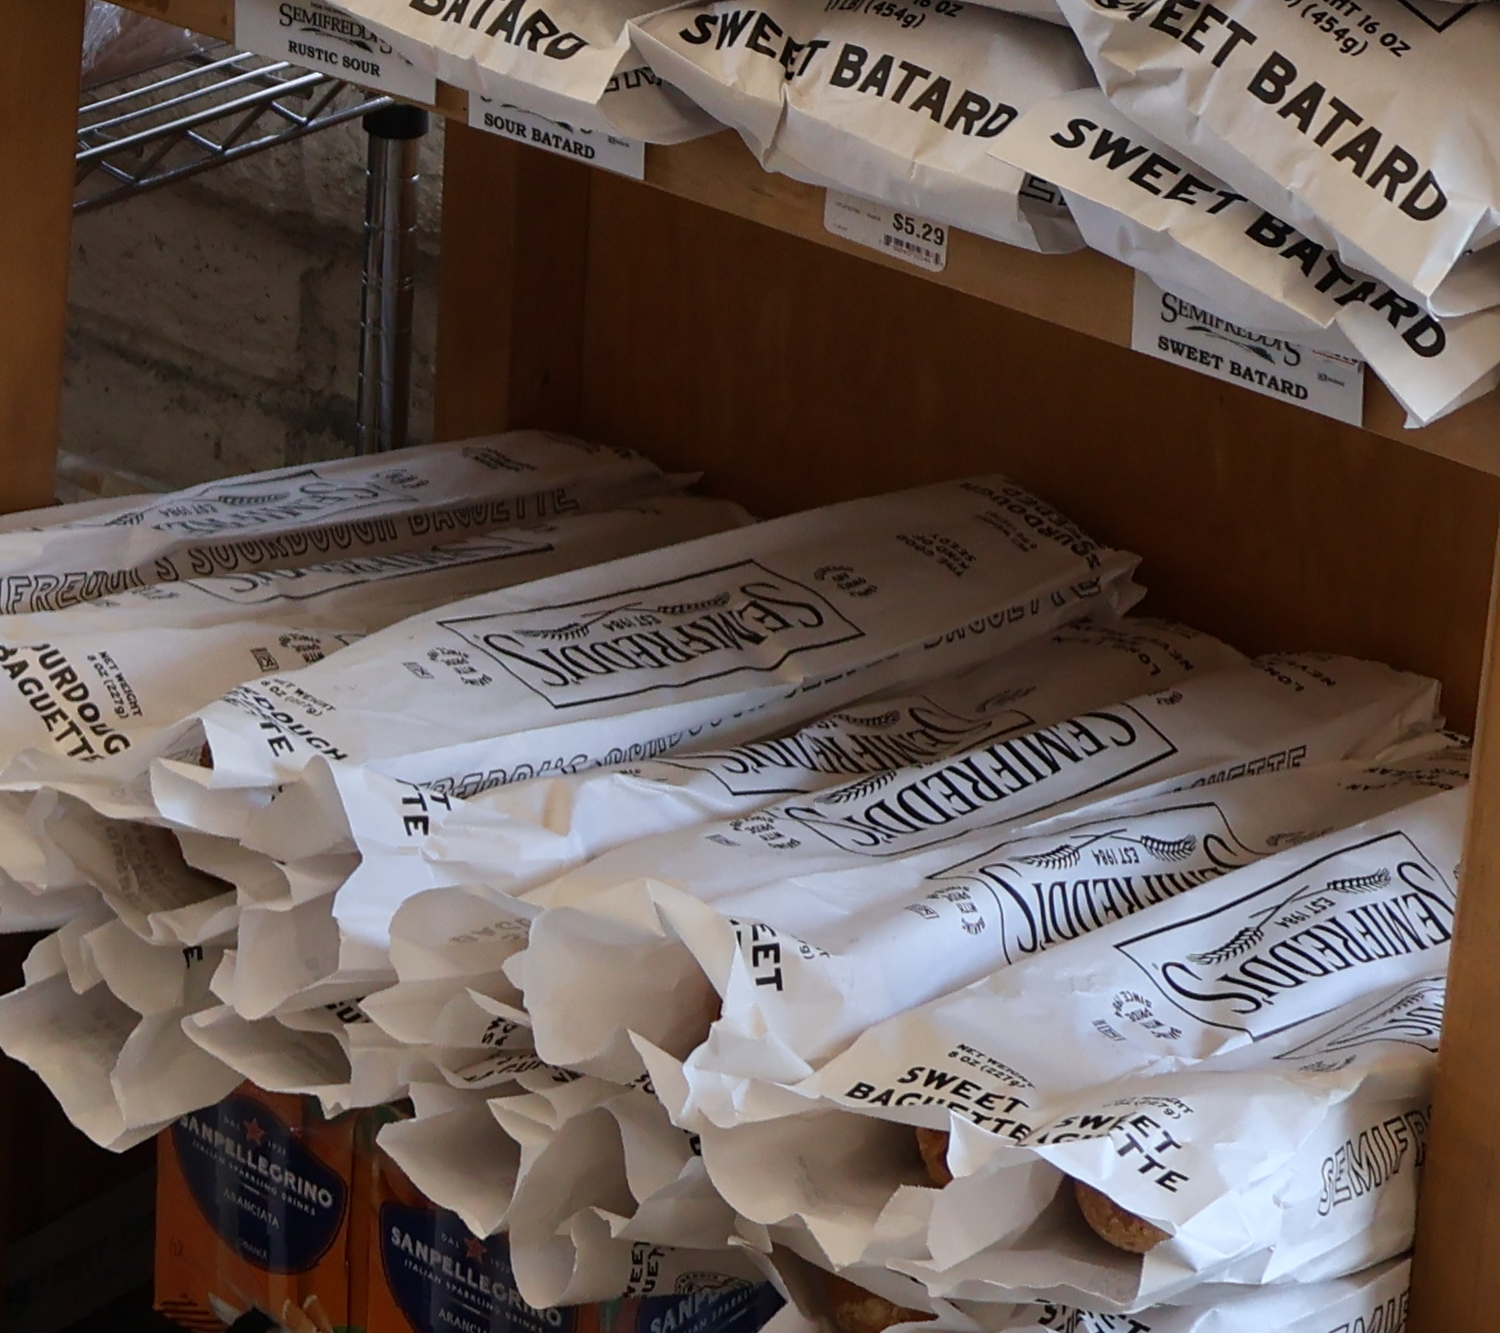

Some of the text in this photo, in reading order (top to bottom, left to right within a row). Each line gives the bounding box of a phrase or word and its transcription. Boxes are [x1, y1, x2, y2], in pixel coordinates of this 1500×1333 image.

[287, 39, 381, 79] RUSTIC SOUR
[483, 112, 596, 161] SOUR BATARD
[1049, 116, 1249, 219] SWEET
[1248, 59, 1449, 224] BATARD
[1156, 334, 1309, 403] SWEET BATARD
[481, 578, 830, 690] SEMIFREDDI'S
[905, 1063, 1031, 1119] SWEET
[179, 1113, 334, 1210] SANPELLEGRINO
[221, 1188, 281, 1229] ARANCIATA
